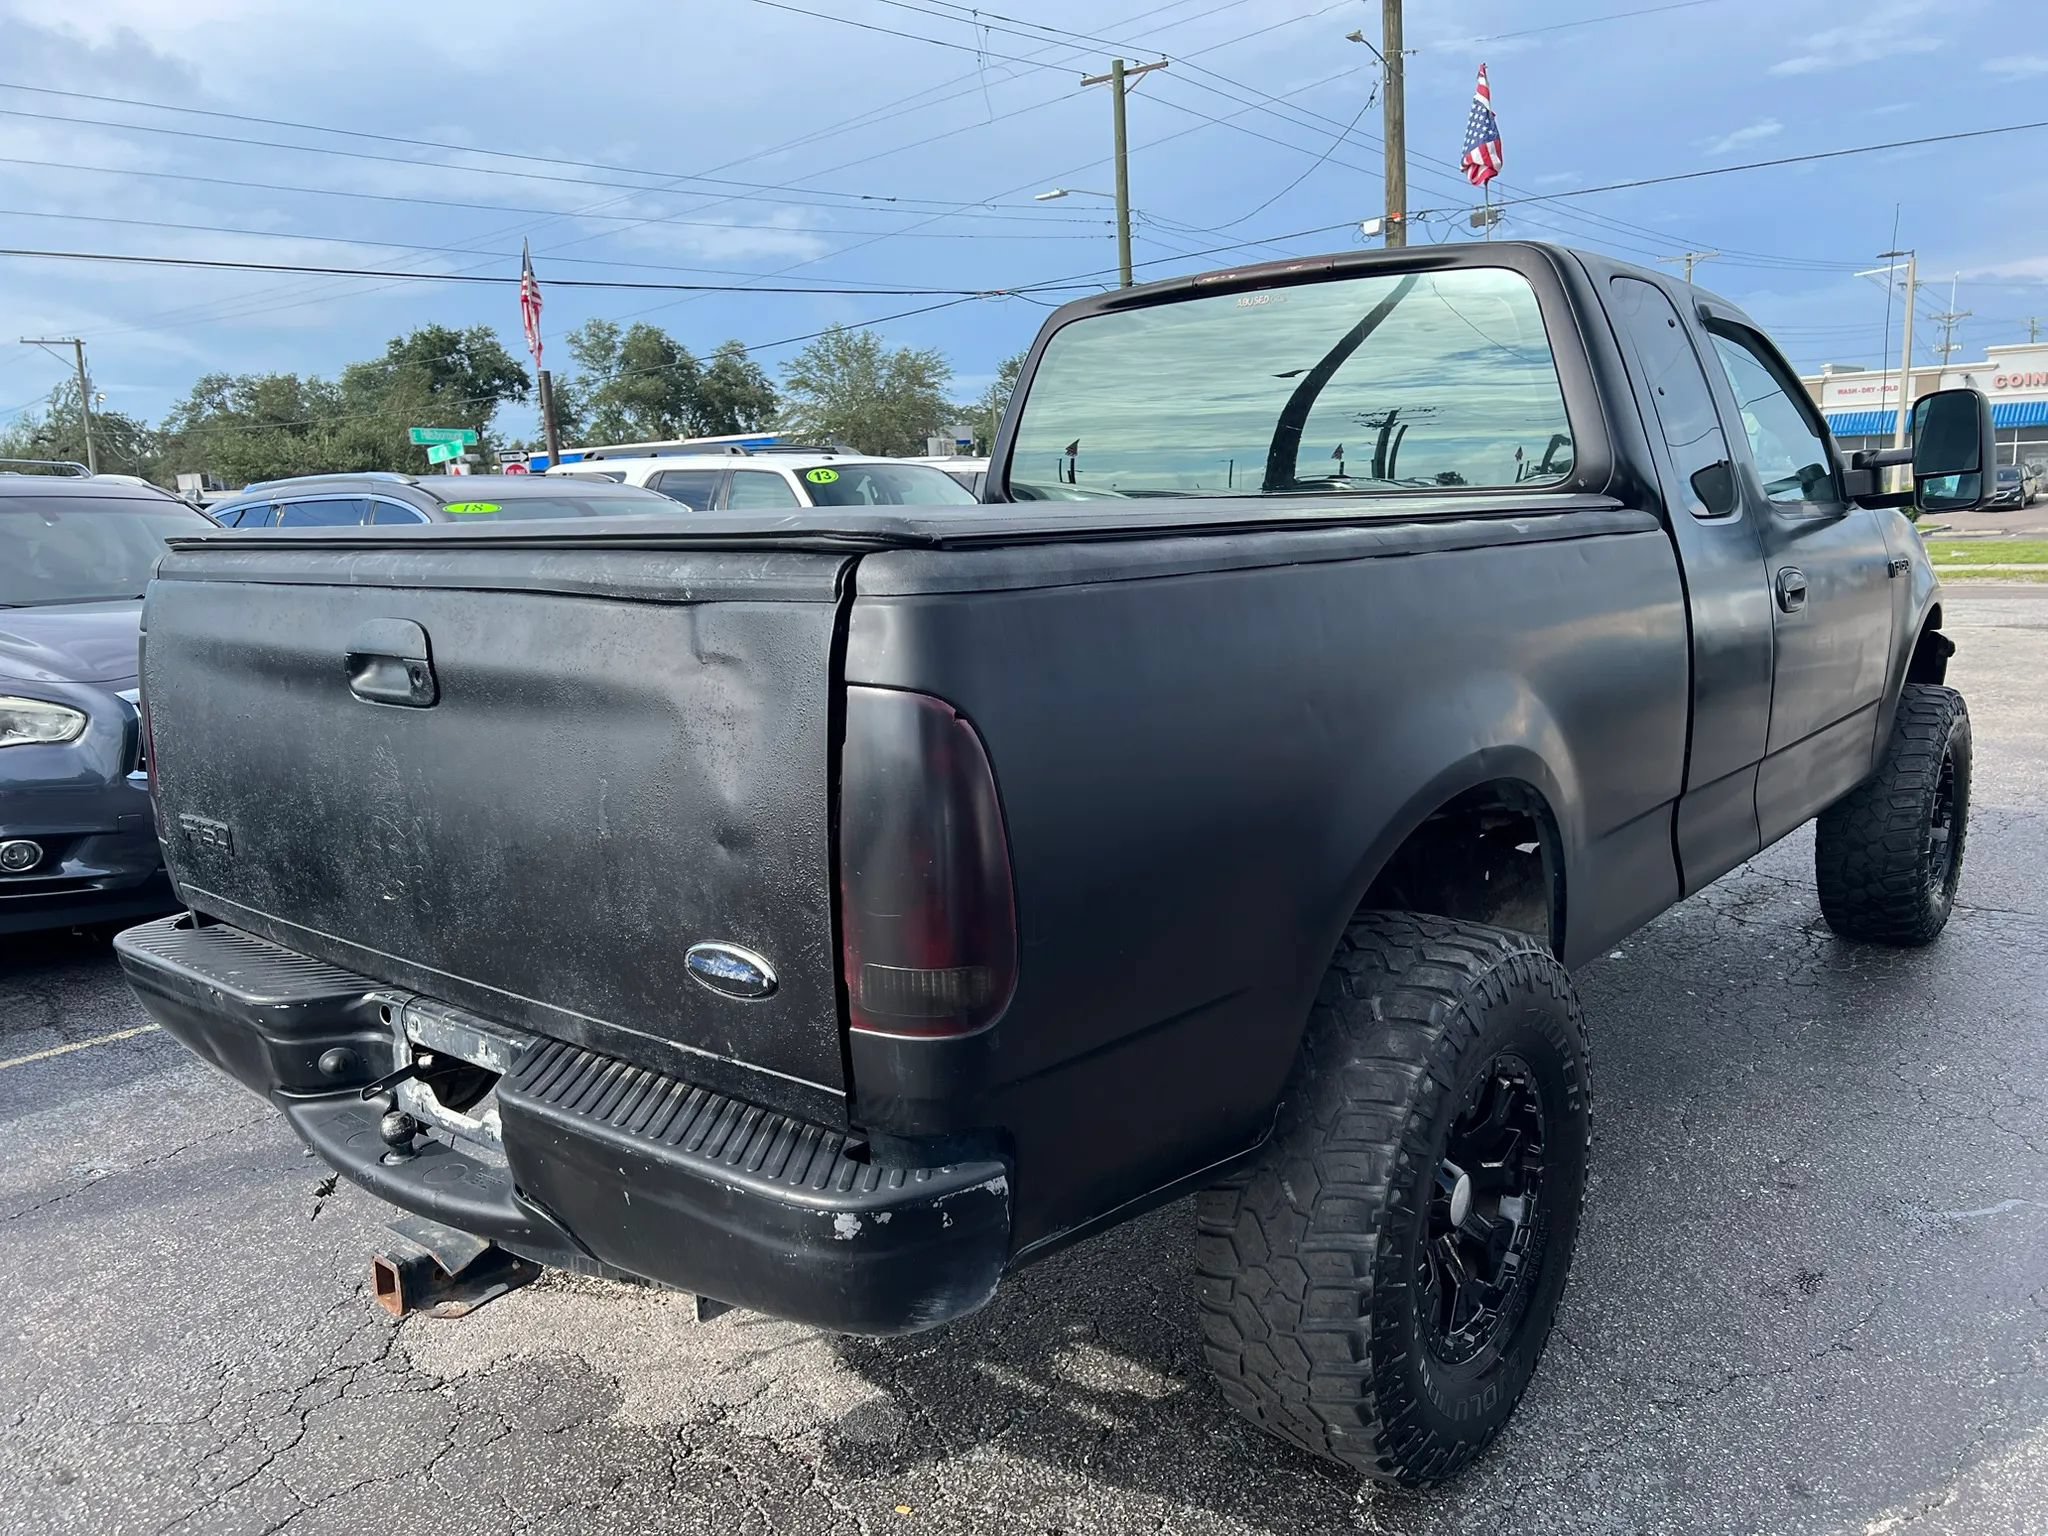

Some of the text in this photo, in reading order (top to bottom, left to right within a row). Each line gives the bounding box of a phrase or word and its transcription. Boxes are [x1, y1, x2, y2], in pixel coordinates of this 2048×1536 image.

[1993, 372, 2048, 388] COIN
[814, 470, 831, 481] 13
[463, 503, 484, 512] 18
